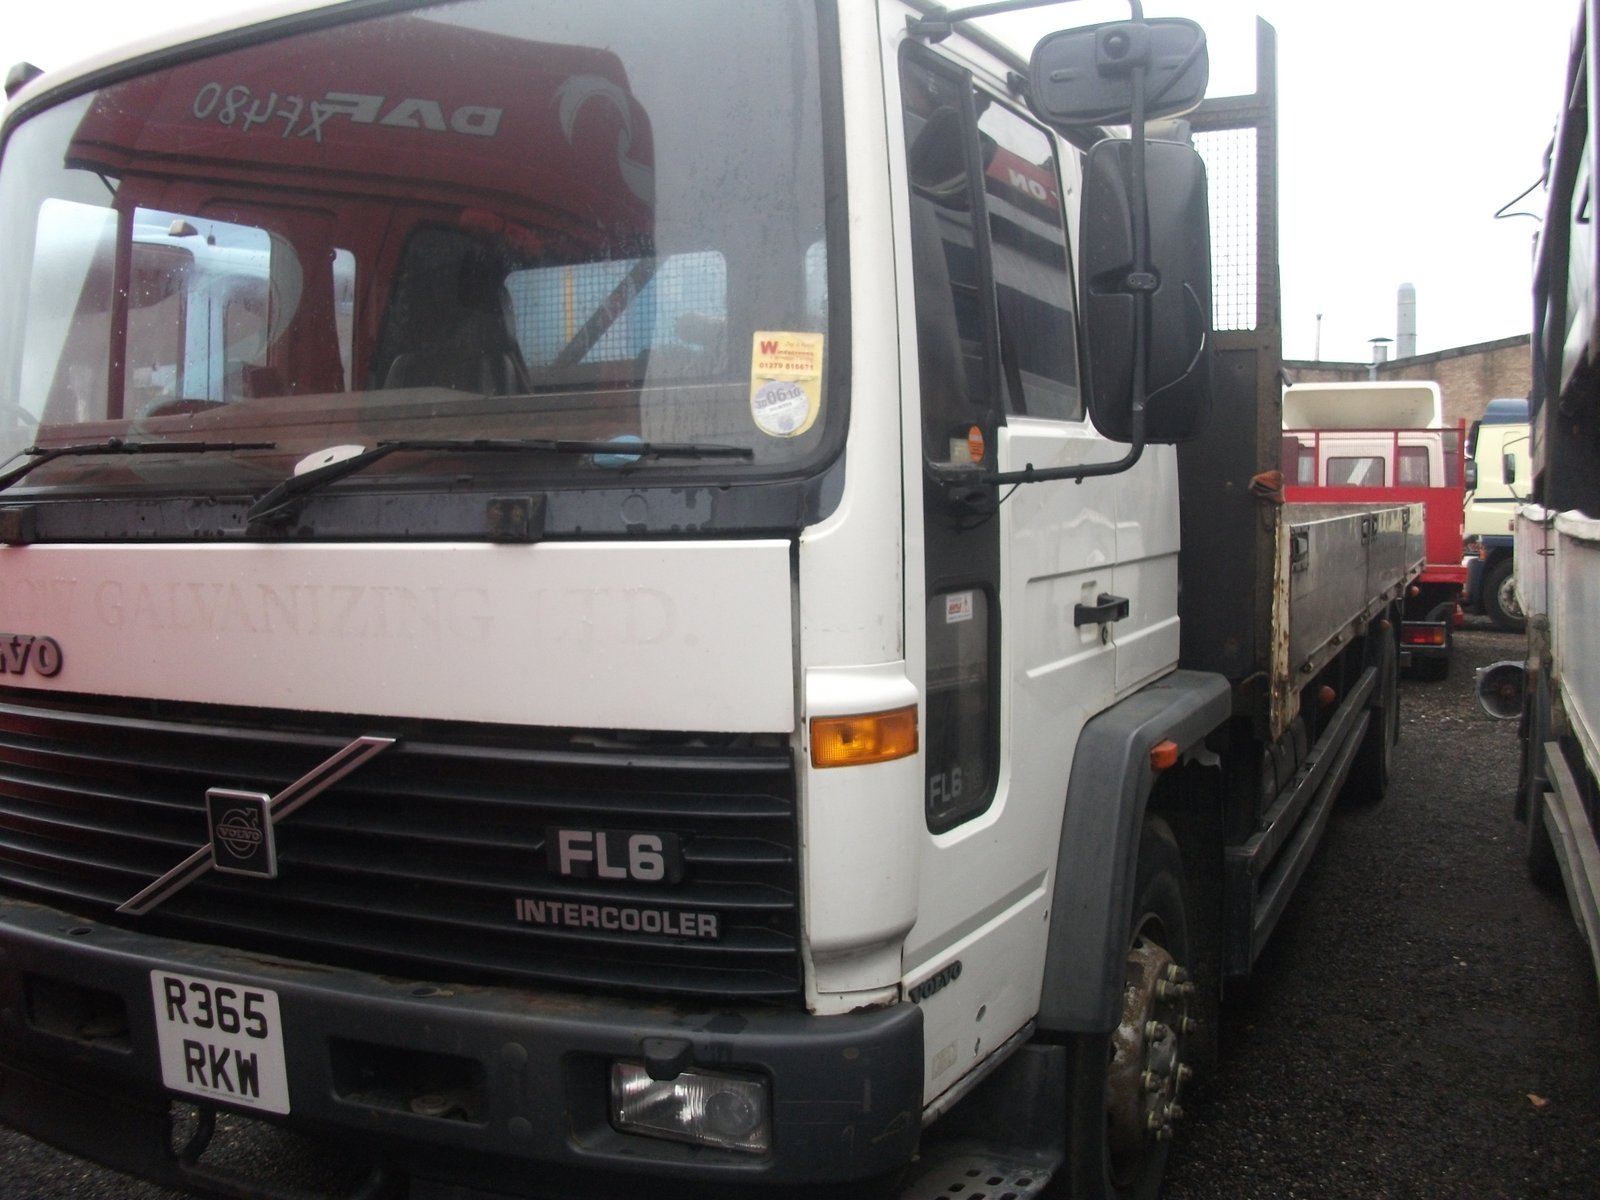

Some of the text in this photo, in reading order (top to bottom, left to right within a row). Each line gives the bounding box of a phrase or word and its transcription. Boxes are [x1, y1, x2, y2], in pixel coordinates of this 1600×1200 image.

[95, 579, 495, 642] GALVANIZING
[219, 827, 261, 841] VOLVO
[558, 830, 665, 881] FL6
[515, 898, 718, 938] INTERCOOLER
[164, 976, 268, 1039] R365
[908, 960, 963, 1004] VOLVO
[183, 1039, 260, 1098] RKW
